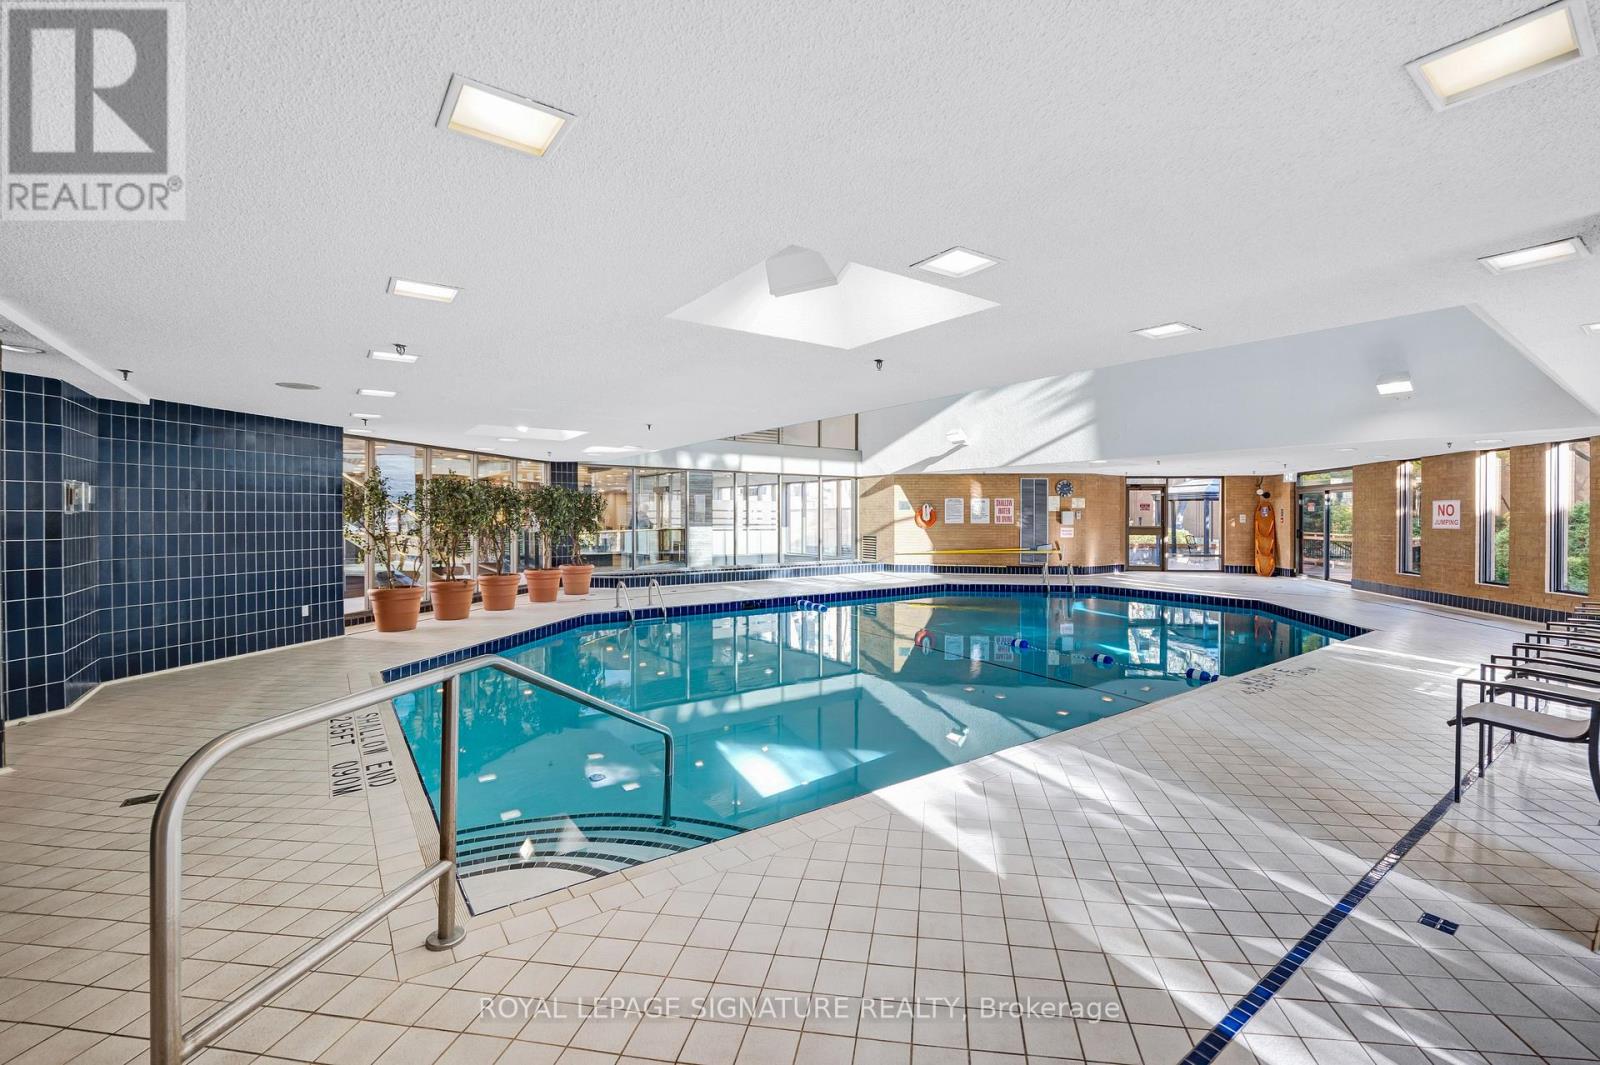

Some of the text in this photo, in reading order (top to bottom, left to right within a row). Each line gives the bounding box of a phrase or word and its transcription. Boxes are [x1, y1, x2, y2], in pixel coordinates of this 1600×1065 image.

[1437, 503, 1455, 517] NO
[1434, 518, 1459, 526] JUMPING
[356, 712, 397, 788] SHALLOW END
